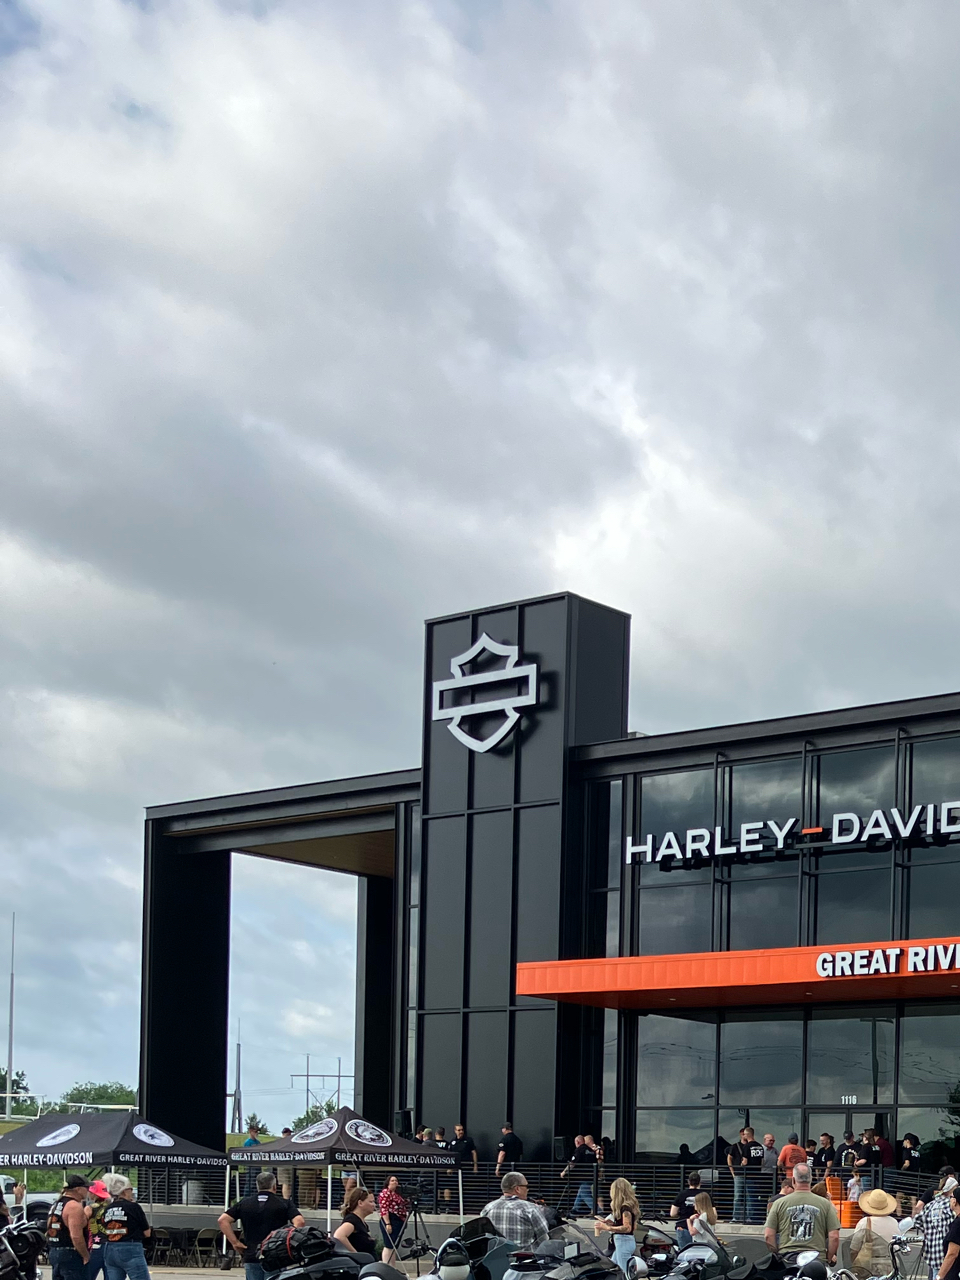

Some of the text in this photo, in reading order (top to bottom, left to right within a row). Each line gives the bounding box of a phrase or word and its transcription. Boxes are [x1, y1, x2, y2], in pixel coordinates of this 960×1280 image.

[816, 948, 901, 977] GREAT
[841, 1095, 857, 1105] 1116
[11, 1152, 93, 1166] HARLEY-DAVIDSON
[119, 1153, 228, 1166] GREAT RIVER HARLEY-DAVIDSO
[231, 1151, 326, 1161] GREAT RIVER HARLEY-DAVIDSON
[335, 1153, 456, 1165] GREAT RIVER HARLEY-DAVIDSON
